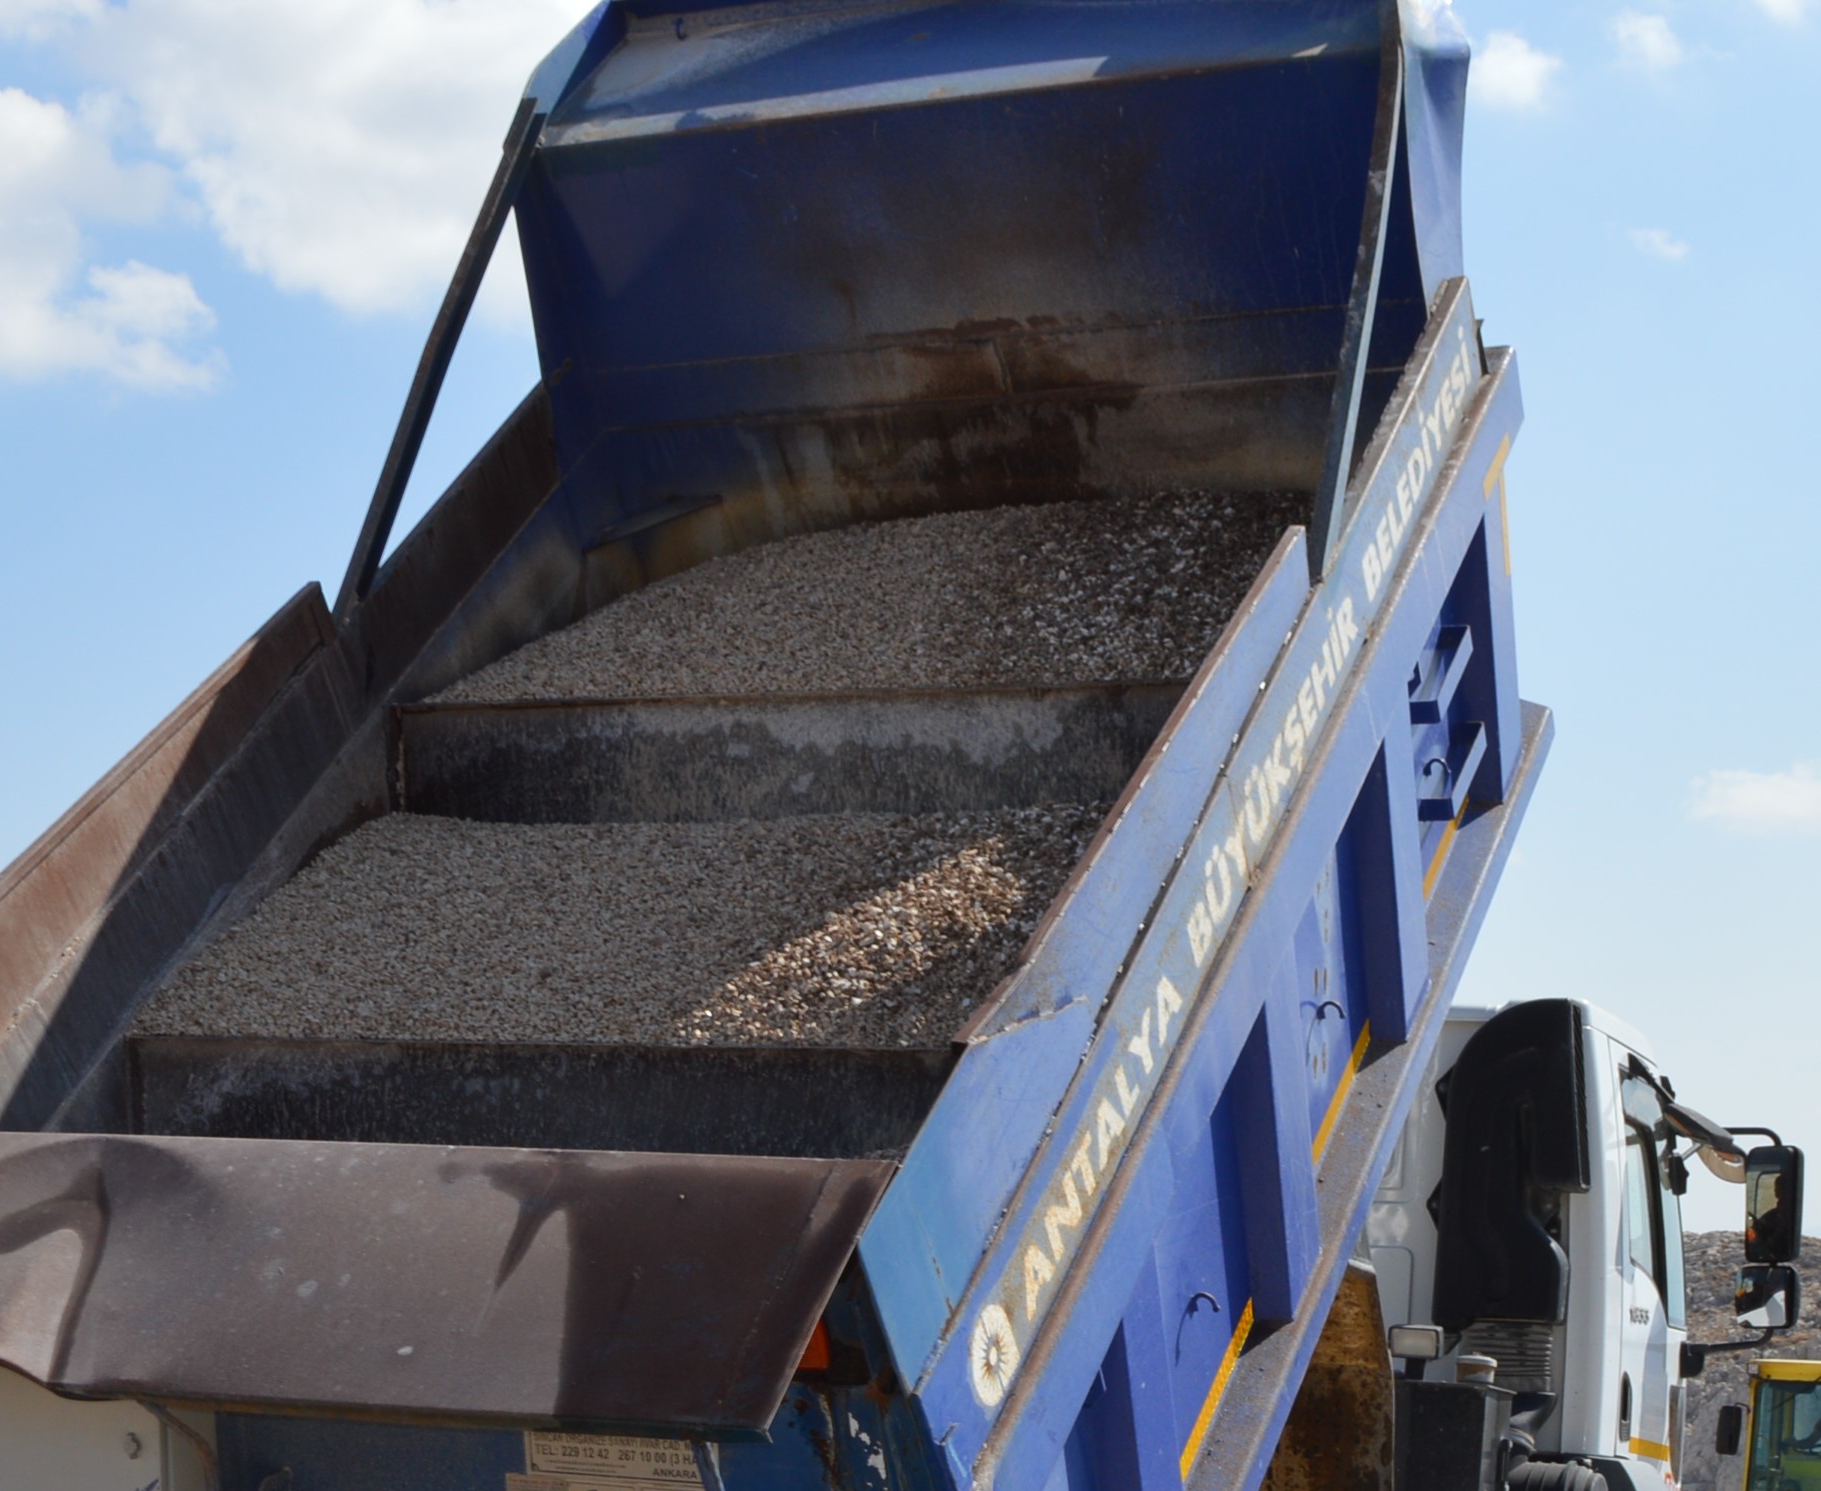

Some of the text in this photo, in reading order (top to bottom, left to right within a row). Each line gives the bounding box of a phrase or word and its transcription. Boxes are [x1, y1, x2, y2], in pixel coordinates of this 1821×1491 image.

[1025, 325, 1472, 1322] ANTALYA BÜYÜKŞEHİR BELEDİYESİ
[535, 1443, 558, 1456] TEL:
[561, 1446, 579, 1458] 229
[582, 1447, 595, 1459] 12
[598, 1448, 610, 1460] 42
[639, 1451, 652, 1463] 10
[654, 1452, 667, 1464] 00
[669, 1453, 680, 1466] (3
[652, 1468, 698, 1480] ANKARA
